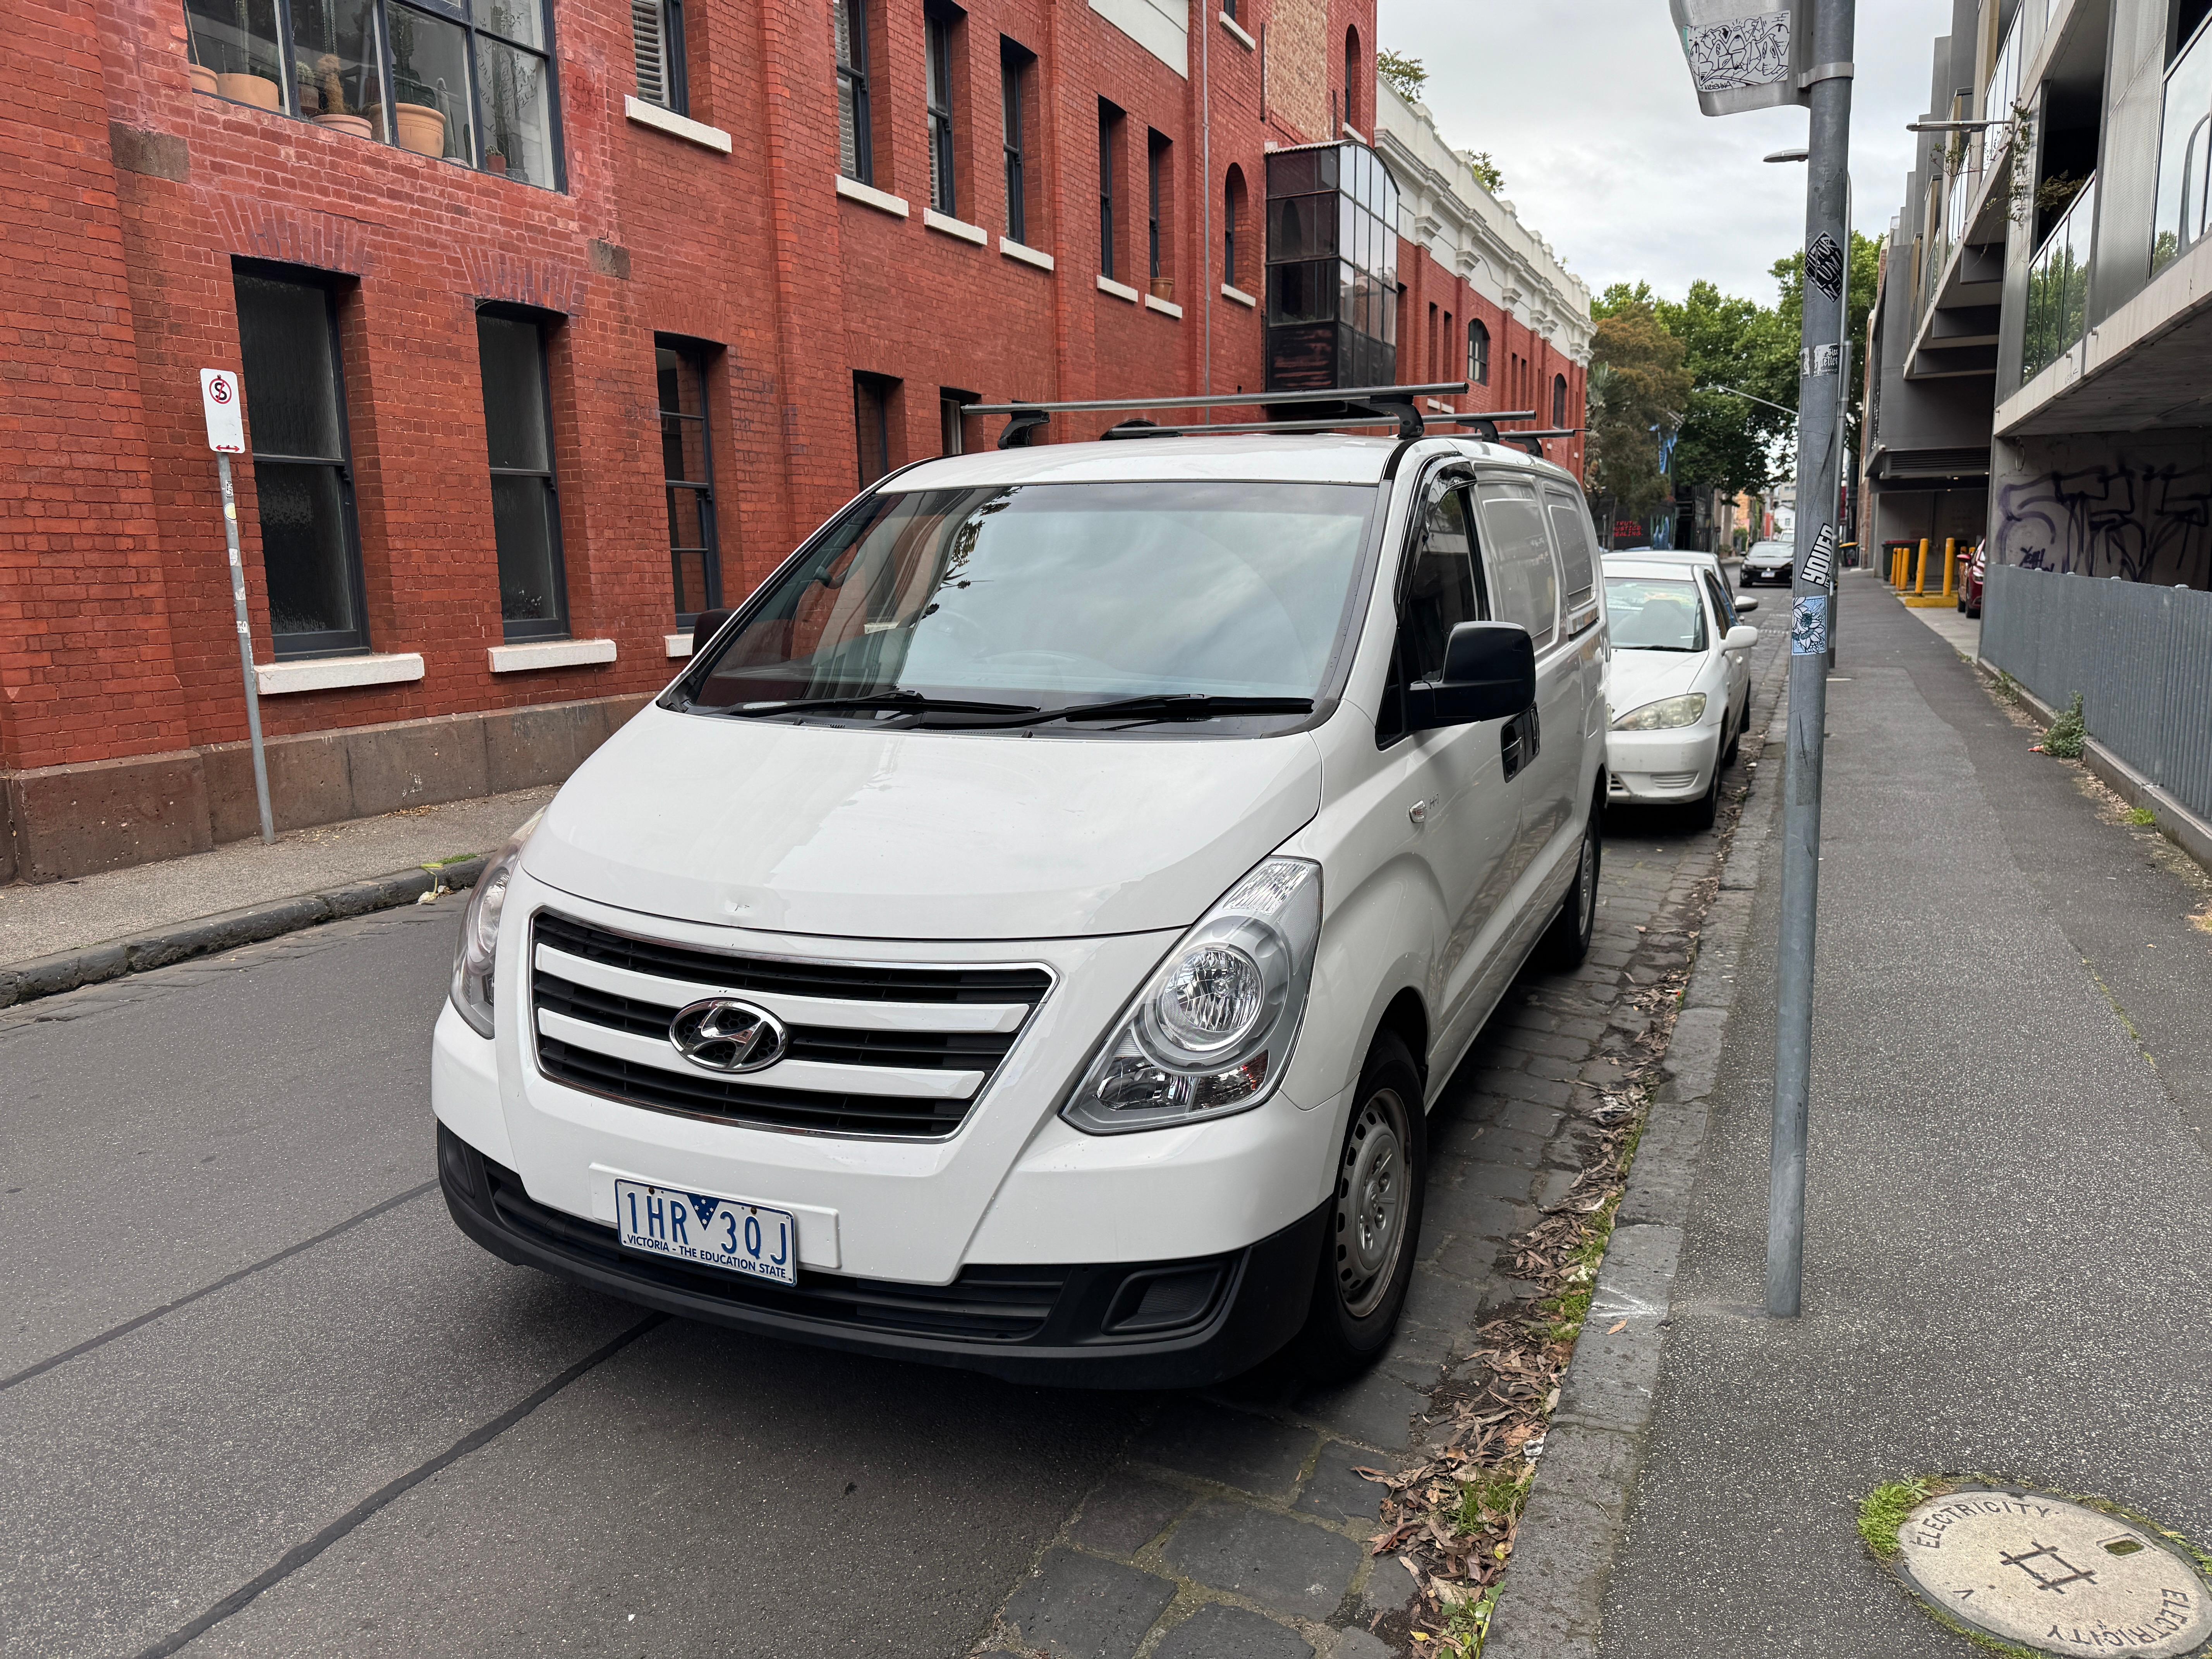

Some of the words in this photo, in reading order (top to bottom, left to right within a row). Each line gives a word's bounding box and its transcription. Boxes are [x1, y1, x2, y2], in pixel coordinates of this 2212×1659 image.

[627, 1192, 689, 1245] 1HR
[720, 1211, 787, 1265] 3QJ
[627, 1234, 670, 1252] VICTORIA
[678, 1245, 697, 1258] THE
[700, 1250, 756, 1271] EDUCATION
[759, 1263, 786, 1278] STATE
[1916, 1501, 2051, 1549] ELECTRICITY
[2047, 1588, 2190, 1647] ELECTRICITY
